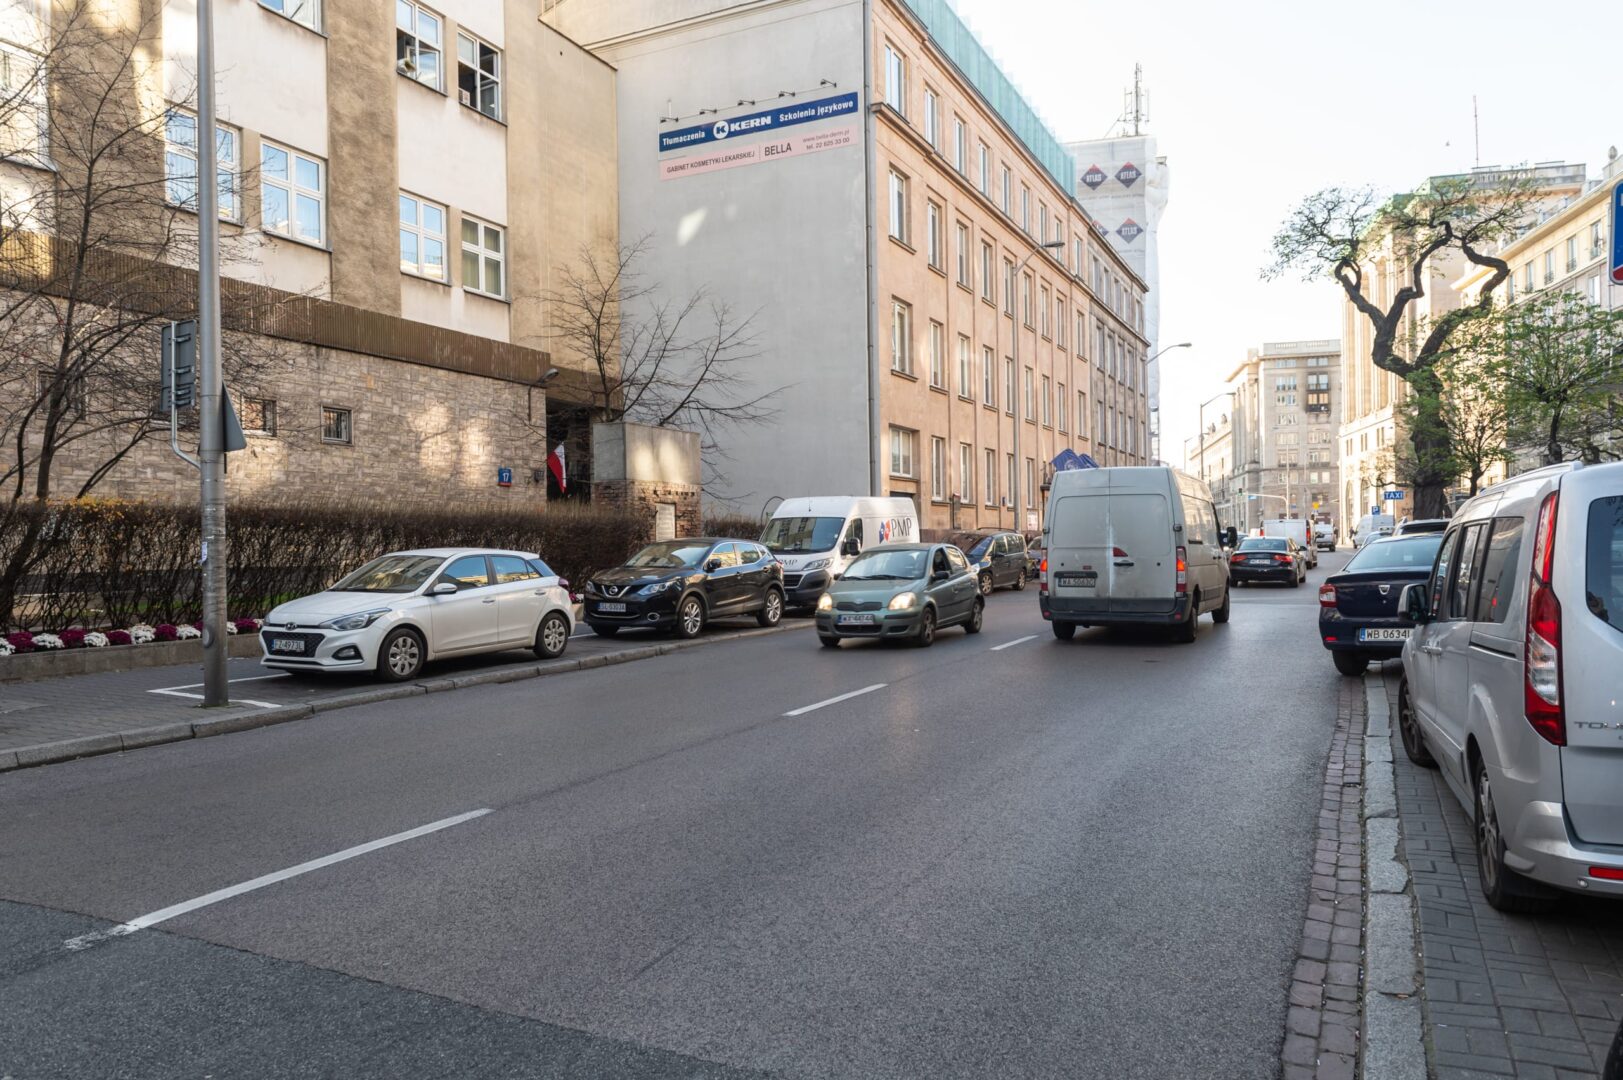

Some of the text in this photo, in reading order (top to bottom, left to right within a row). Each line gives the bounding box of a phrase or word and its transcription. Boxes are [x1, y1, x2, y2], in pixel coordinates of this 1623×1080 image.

[730, 115, 772, 132] KERN
[779, 108, 816, 122] Szkolenia
[817, 100, 854, 116] językowe
[764, 142, 792, 156] BELLA
[666, 150, 755, 173] GABINET KOSMETYKI LEKARSKIEJ
[502, 472, 510, 482] 17
[890, 517, 912, 538] PMP
[1367, 629, 1380, 639] WB
[1573, 721, 1623, 730] TOU
